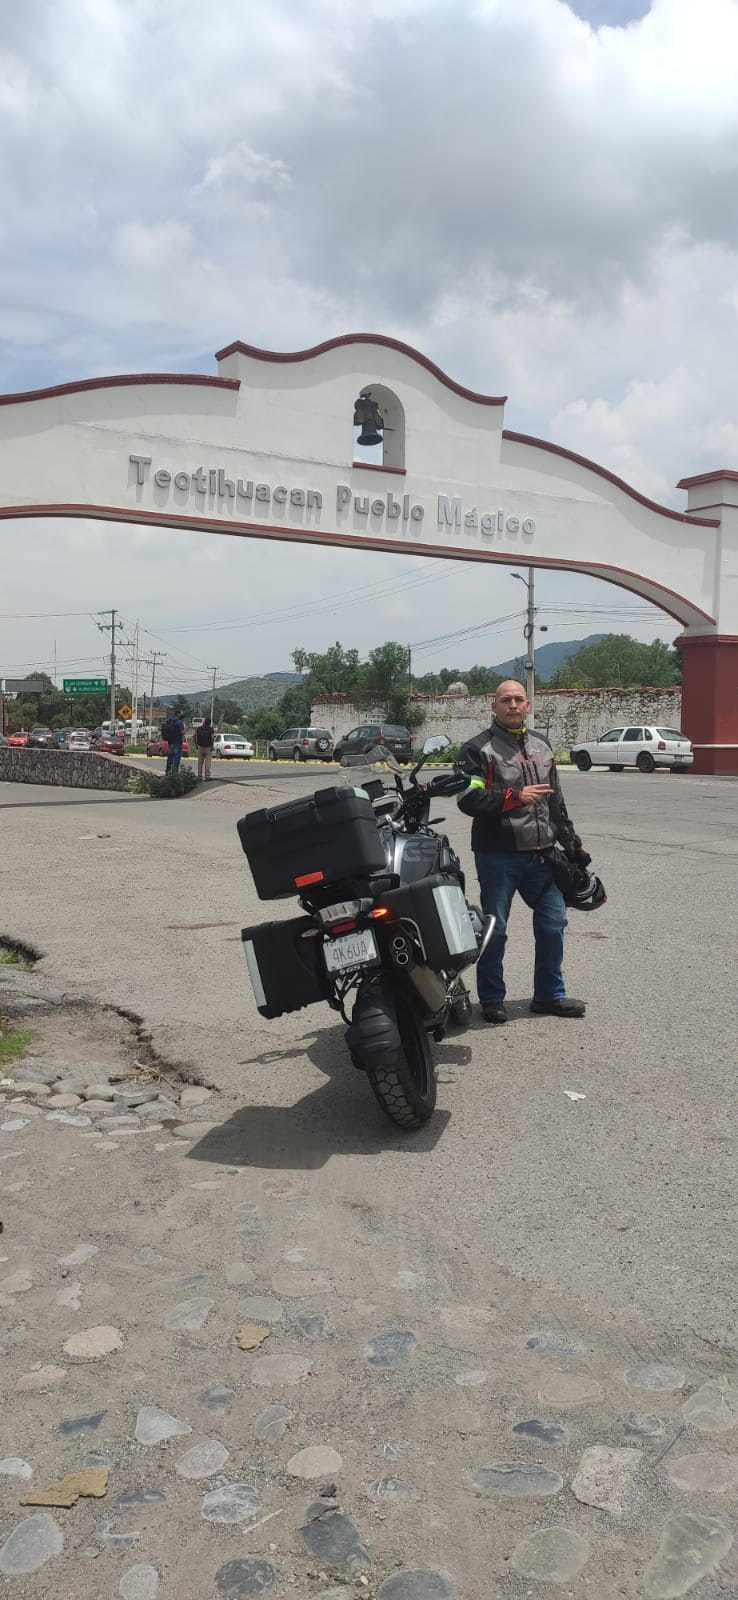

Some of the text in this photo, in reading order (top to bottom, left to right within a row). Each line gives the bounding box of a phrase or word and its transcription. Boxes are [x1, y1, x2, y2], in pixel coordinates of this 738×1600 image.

[129, 454, 536, 535] Teotihuacan Pueblo Mágico
